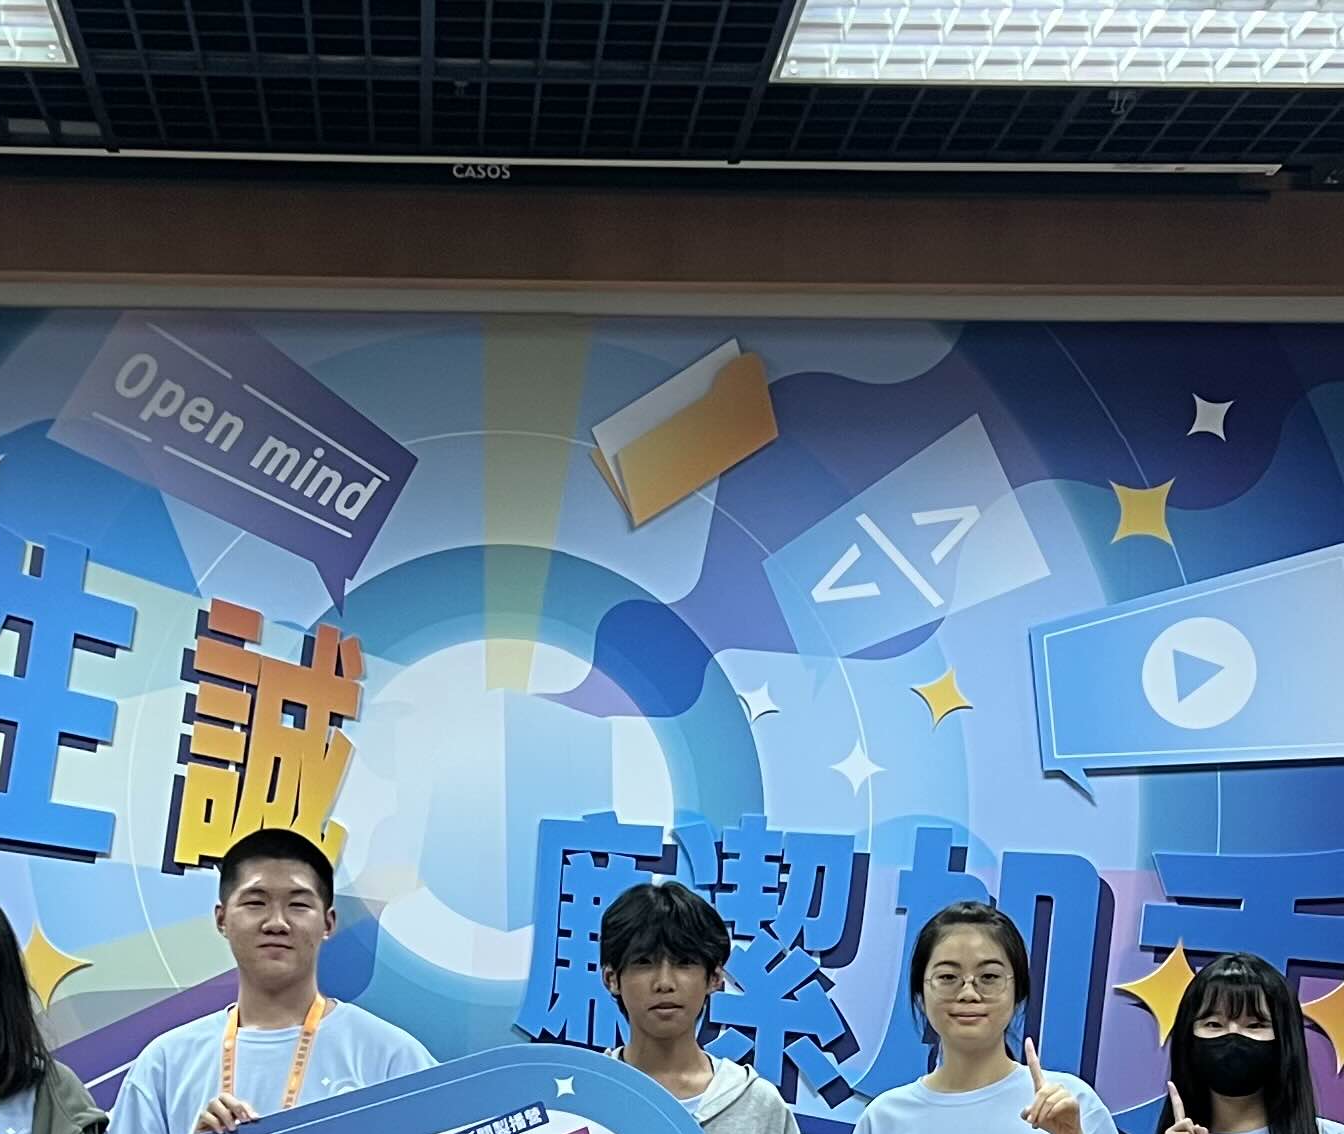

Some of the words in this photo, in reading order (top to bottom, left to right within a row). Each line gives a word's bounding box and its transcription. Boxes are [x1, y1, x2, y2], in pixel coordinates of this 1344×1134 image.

[452, 164, 511, 180] CASOS
[115, 353, 245, 453] Open
[249, 436, 383, 521] mind
